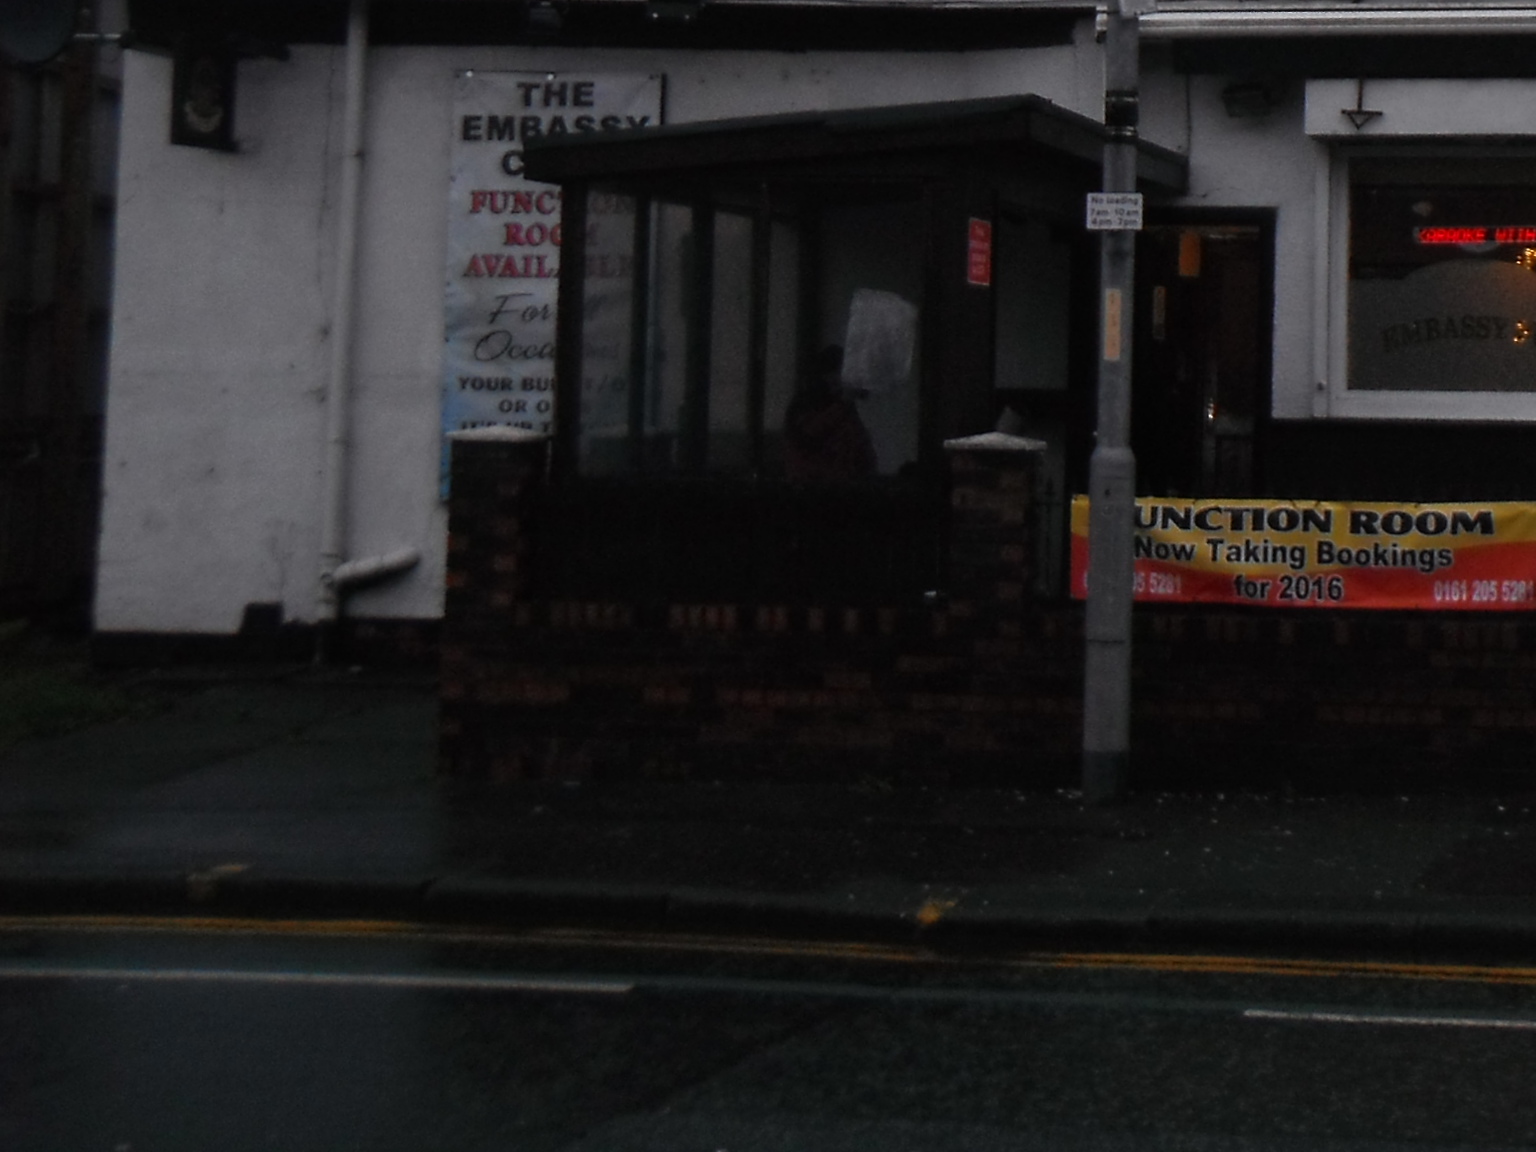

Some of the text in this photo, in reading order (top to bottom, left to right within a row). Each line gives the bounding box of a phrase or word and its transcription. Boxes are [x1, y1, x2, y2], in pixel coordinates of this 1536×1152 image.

[516, 81, 595, 108] THE
[1381, 313, 1509, 354] EMBASSY
[458, 376, 513, 392] YOUR
[498, 399, 527, 414] OR
[1134, 505, 1496, 537] UNCTION ROOM
[1134, 535, 1452, 573] Now Taking Bookings
[1149, 572, 1183, 595] 5281
[1233, 573, 1345, 601] for 2016
[1433, 578, 1535, 602] 0161 205 5281
